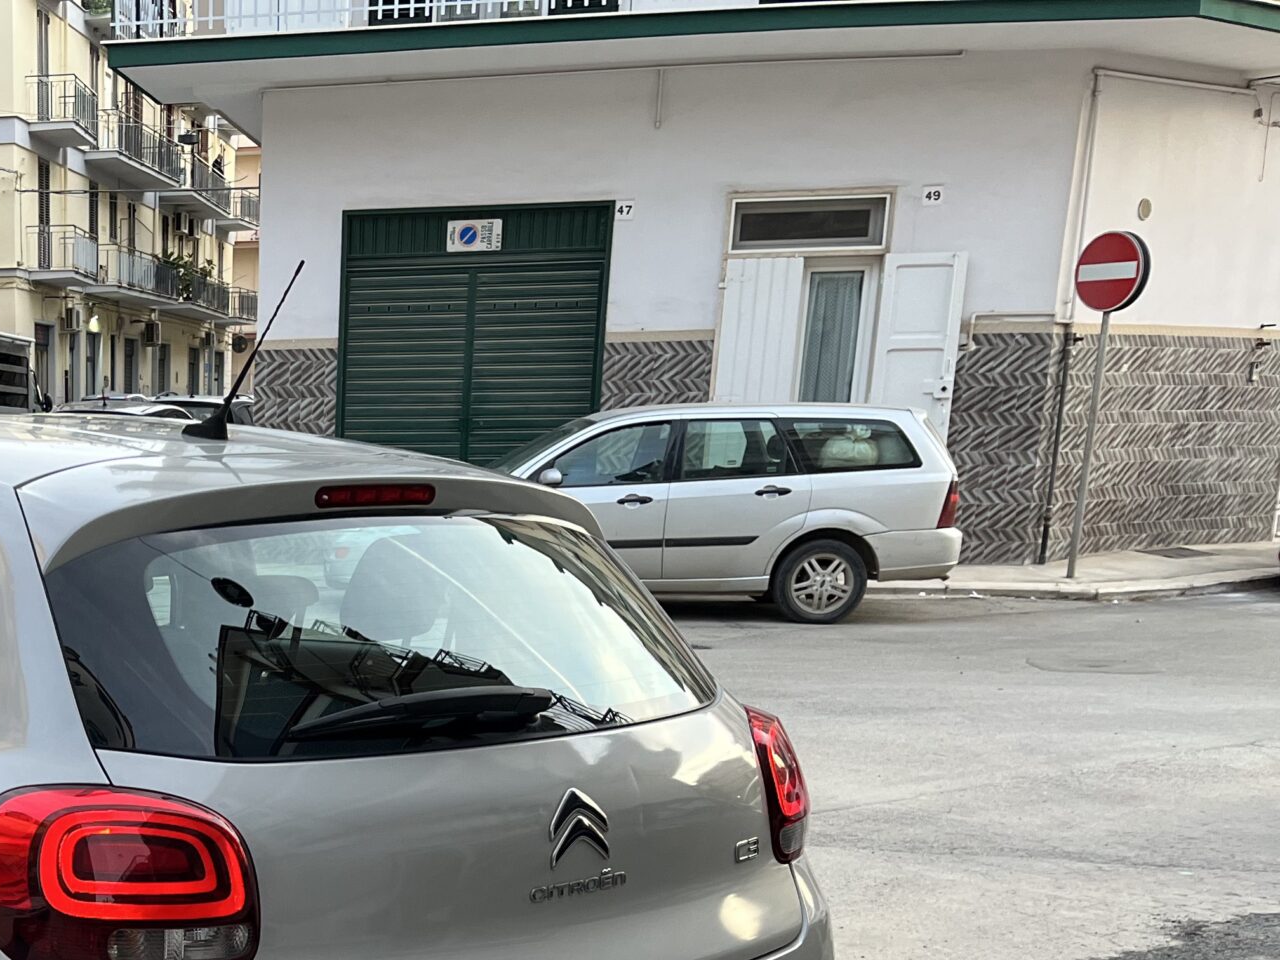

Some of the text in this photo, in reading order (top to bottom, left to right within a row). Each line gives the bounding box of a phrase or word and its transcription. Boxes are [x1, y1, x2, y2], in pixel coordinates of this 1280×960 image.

[925, 190, 941, 201] 49
[617, 205, 633, 216] 47
[735, 836, 759, 863] C3
[529, 867, 626, 903] CITROËN
